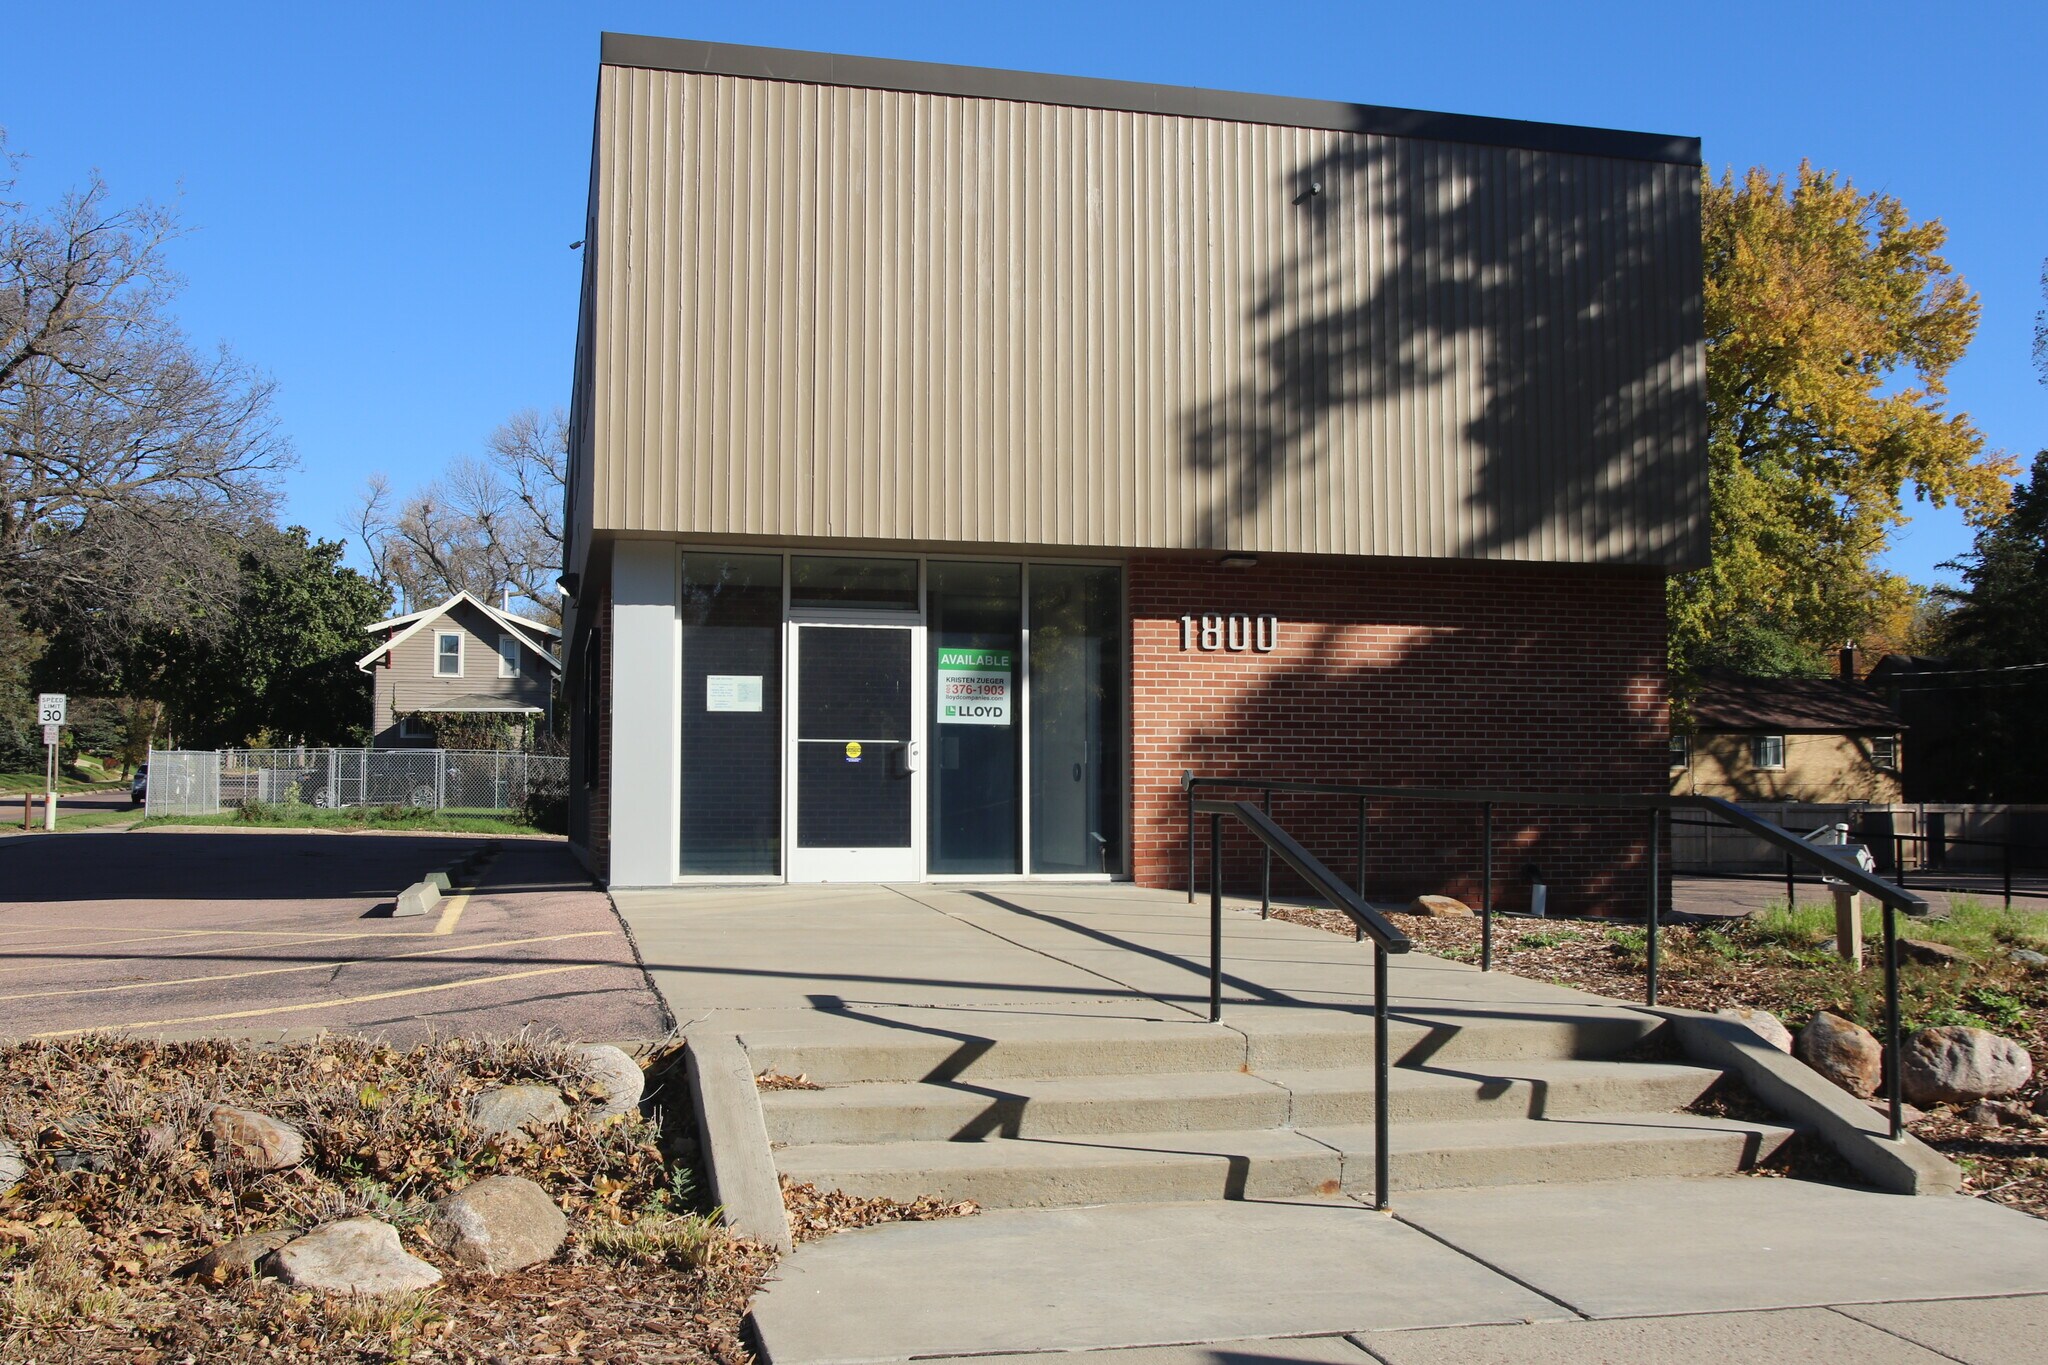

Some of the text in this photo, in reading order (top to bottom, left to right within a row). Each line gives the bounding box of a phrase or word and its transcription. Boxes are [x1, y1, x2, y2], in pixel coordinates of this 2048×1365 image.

[1181, 612, 1277, 650] 1800
[941, 654, 1009, 666] AVAILABLE
[952, 684, 1004, 695] 376-1903
[43, 710, 61, 721] 30
[959, 705, 1003, 717] LLOYD
